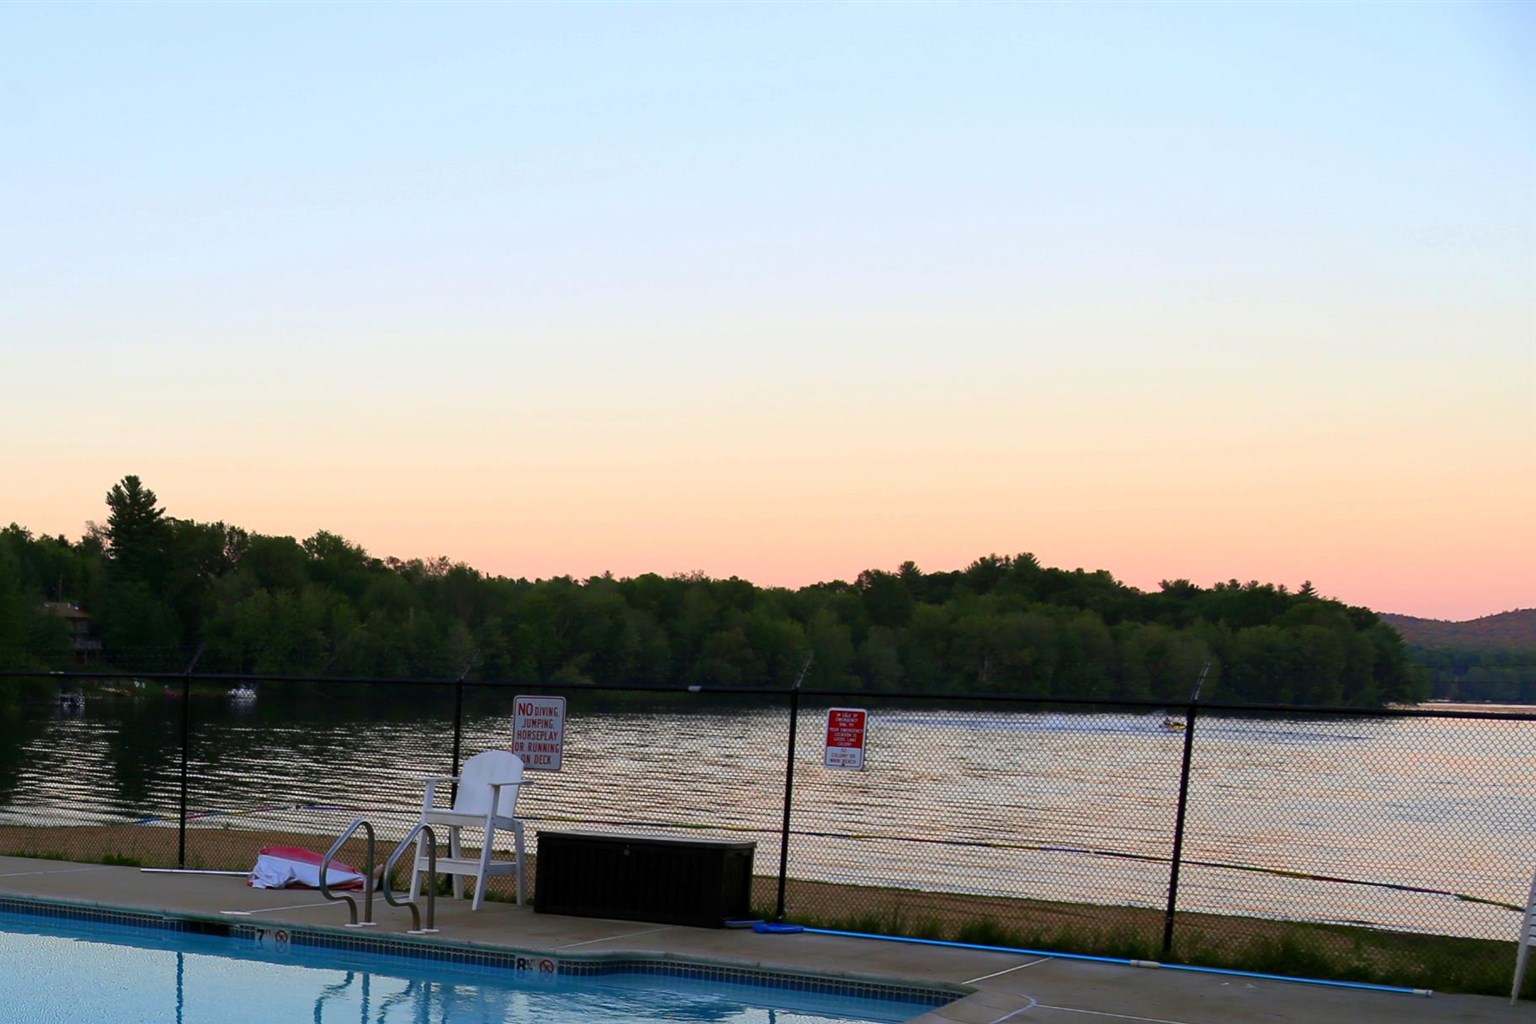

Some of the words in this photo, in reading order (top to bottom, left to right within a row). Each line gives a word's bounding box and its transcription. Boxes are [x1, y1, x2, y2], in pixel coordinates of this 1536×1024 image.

[518, 703, 533, 716] NO
[517, 730, 558, 741] HORSEPLAY
[514, 742, 524, 752] OR
[528, 743, 559, 753] RUNNING
[521, 754, 530, 763] ON
[534, 755, 551, 765] DECK
